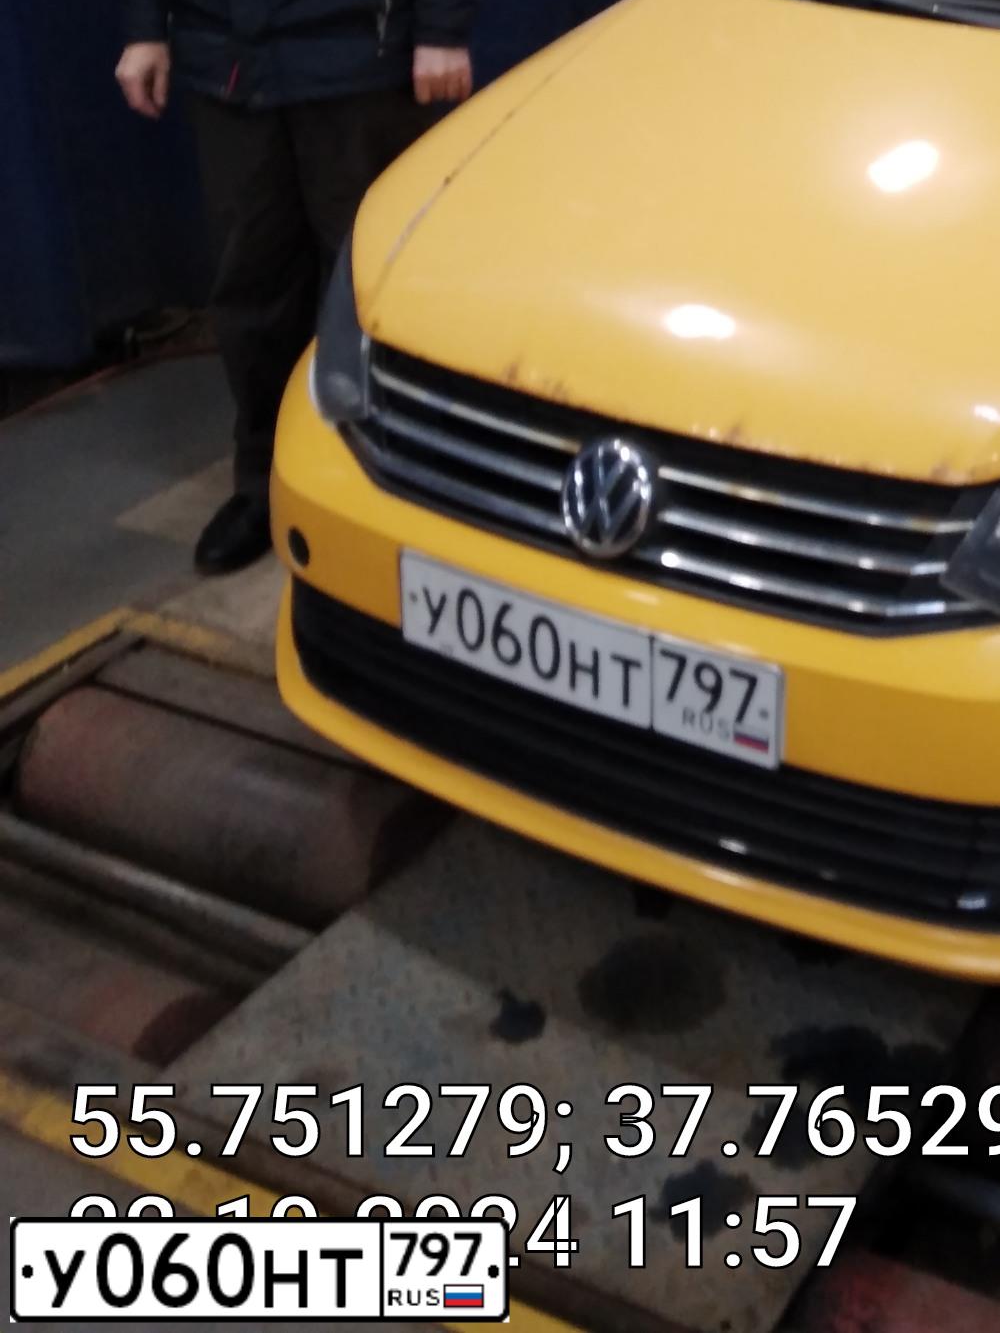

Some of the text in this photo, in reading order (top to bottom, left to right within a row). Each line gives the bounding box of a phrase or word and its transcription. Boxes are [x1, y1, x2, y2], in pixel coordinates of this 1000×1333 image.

[421, 586, 759, 725] У060НТ 797
[682, 707, 731, 741] RUS
